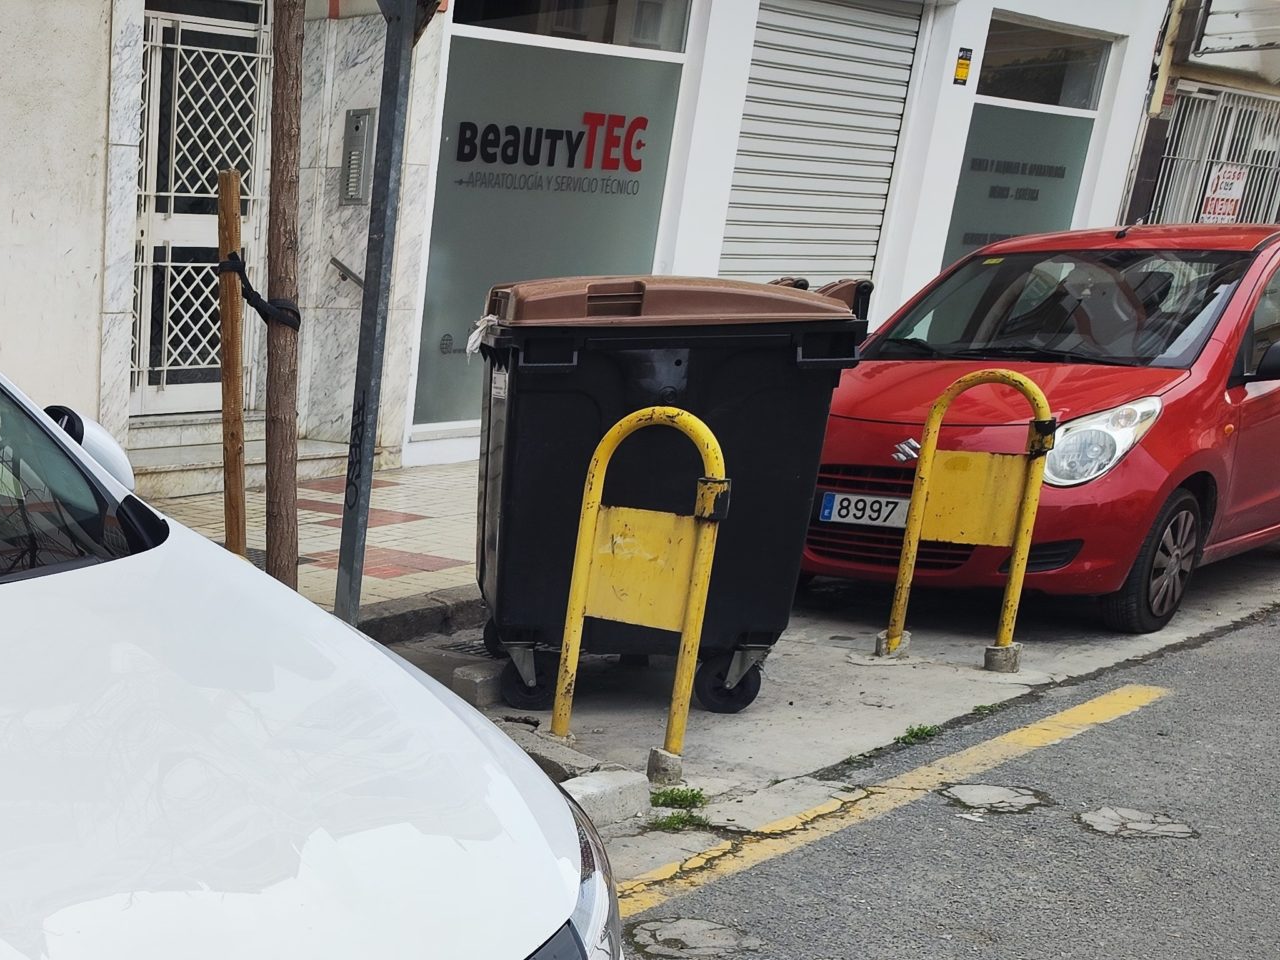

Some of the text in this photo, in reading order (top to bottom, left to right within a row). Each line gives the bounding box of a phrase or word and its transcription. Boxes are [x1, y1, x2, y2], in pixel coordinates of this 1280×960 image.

[468, 170, 639, 195] APARATOLOGÍA Y SERVICIO TÉCNICO
[837, 497, 899, 522] 8997
